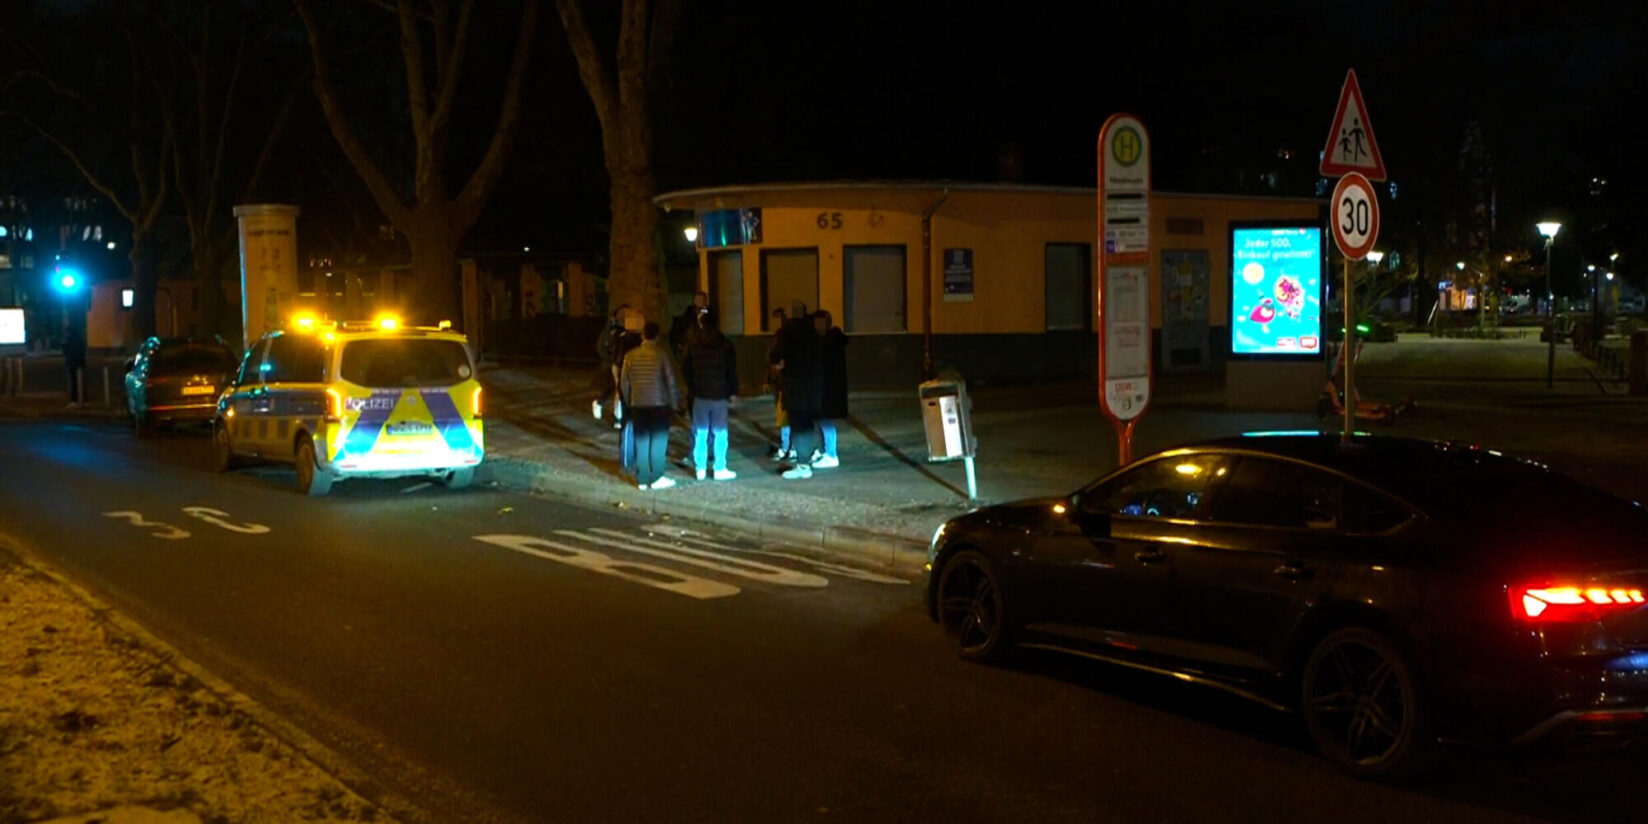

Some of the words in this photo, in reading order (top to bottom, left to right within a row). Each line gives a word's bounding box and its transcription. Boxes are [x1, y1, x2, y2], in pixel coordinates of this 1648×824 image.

[1120, 135, 1134, 158] H
[817, 212, 843, 230] 65
[1341, 196, 1369, 237] 30
[344, 397, 394, 410] POLIZEI
